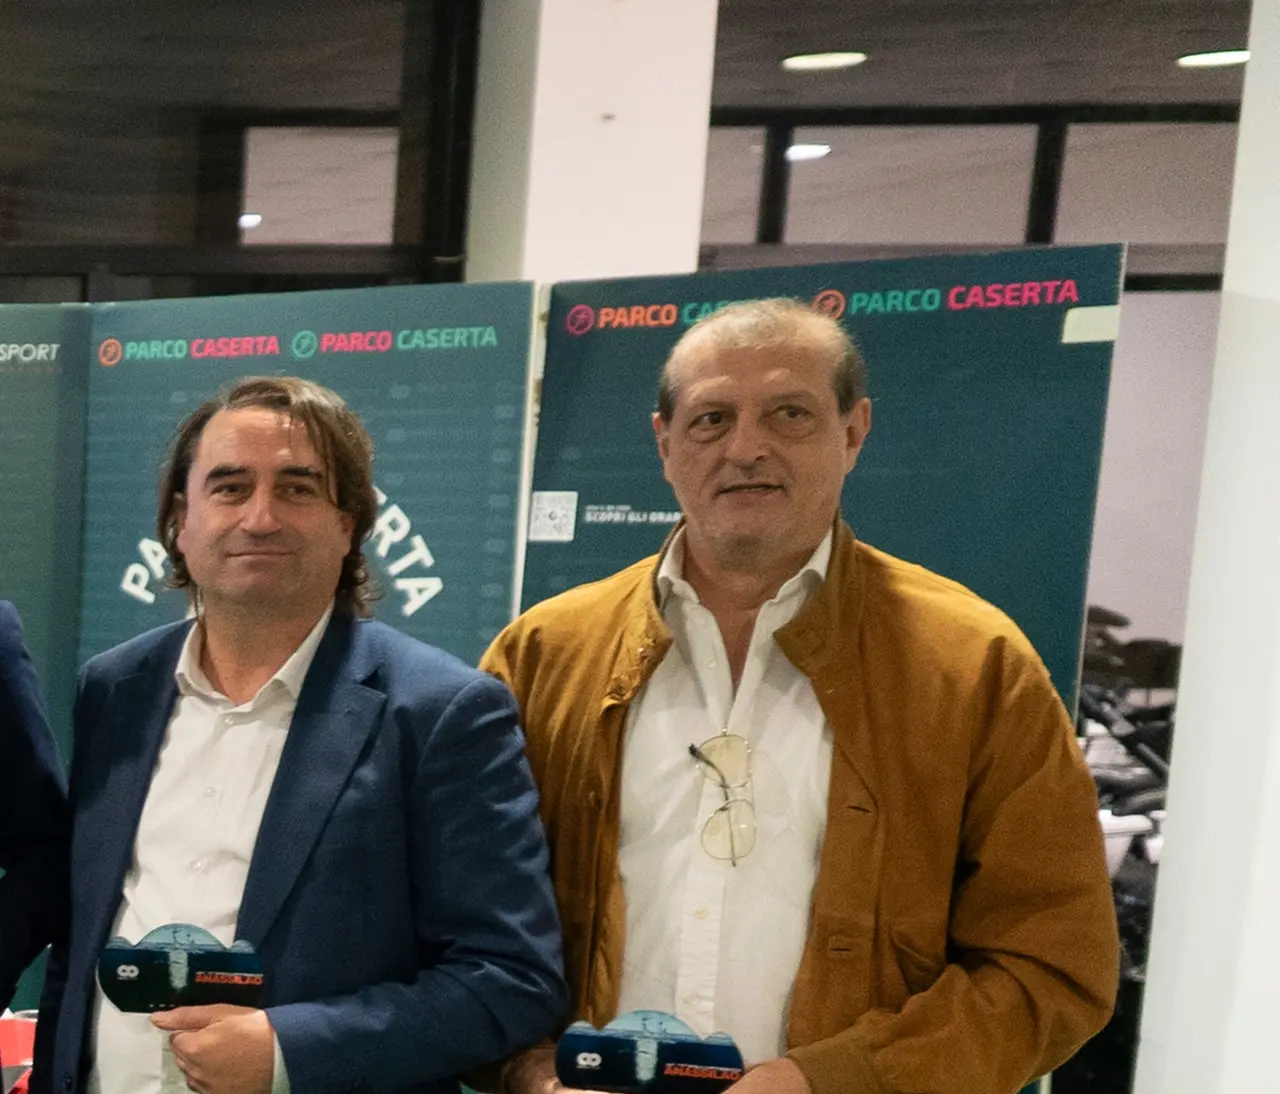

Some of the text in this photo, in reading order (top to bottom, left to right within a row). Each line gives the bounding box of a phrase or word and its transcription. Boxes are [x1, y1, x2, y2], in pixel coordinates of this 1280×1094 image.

[850, 280, 1080, 314] PARCO CASERTA
[597, 303, 677, 329] PARCO
[124, 335, 280, 360] PARCO CASERTA
[320, 325, 498, 353] PARCO CASERTA
